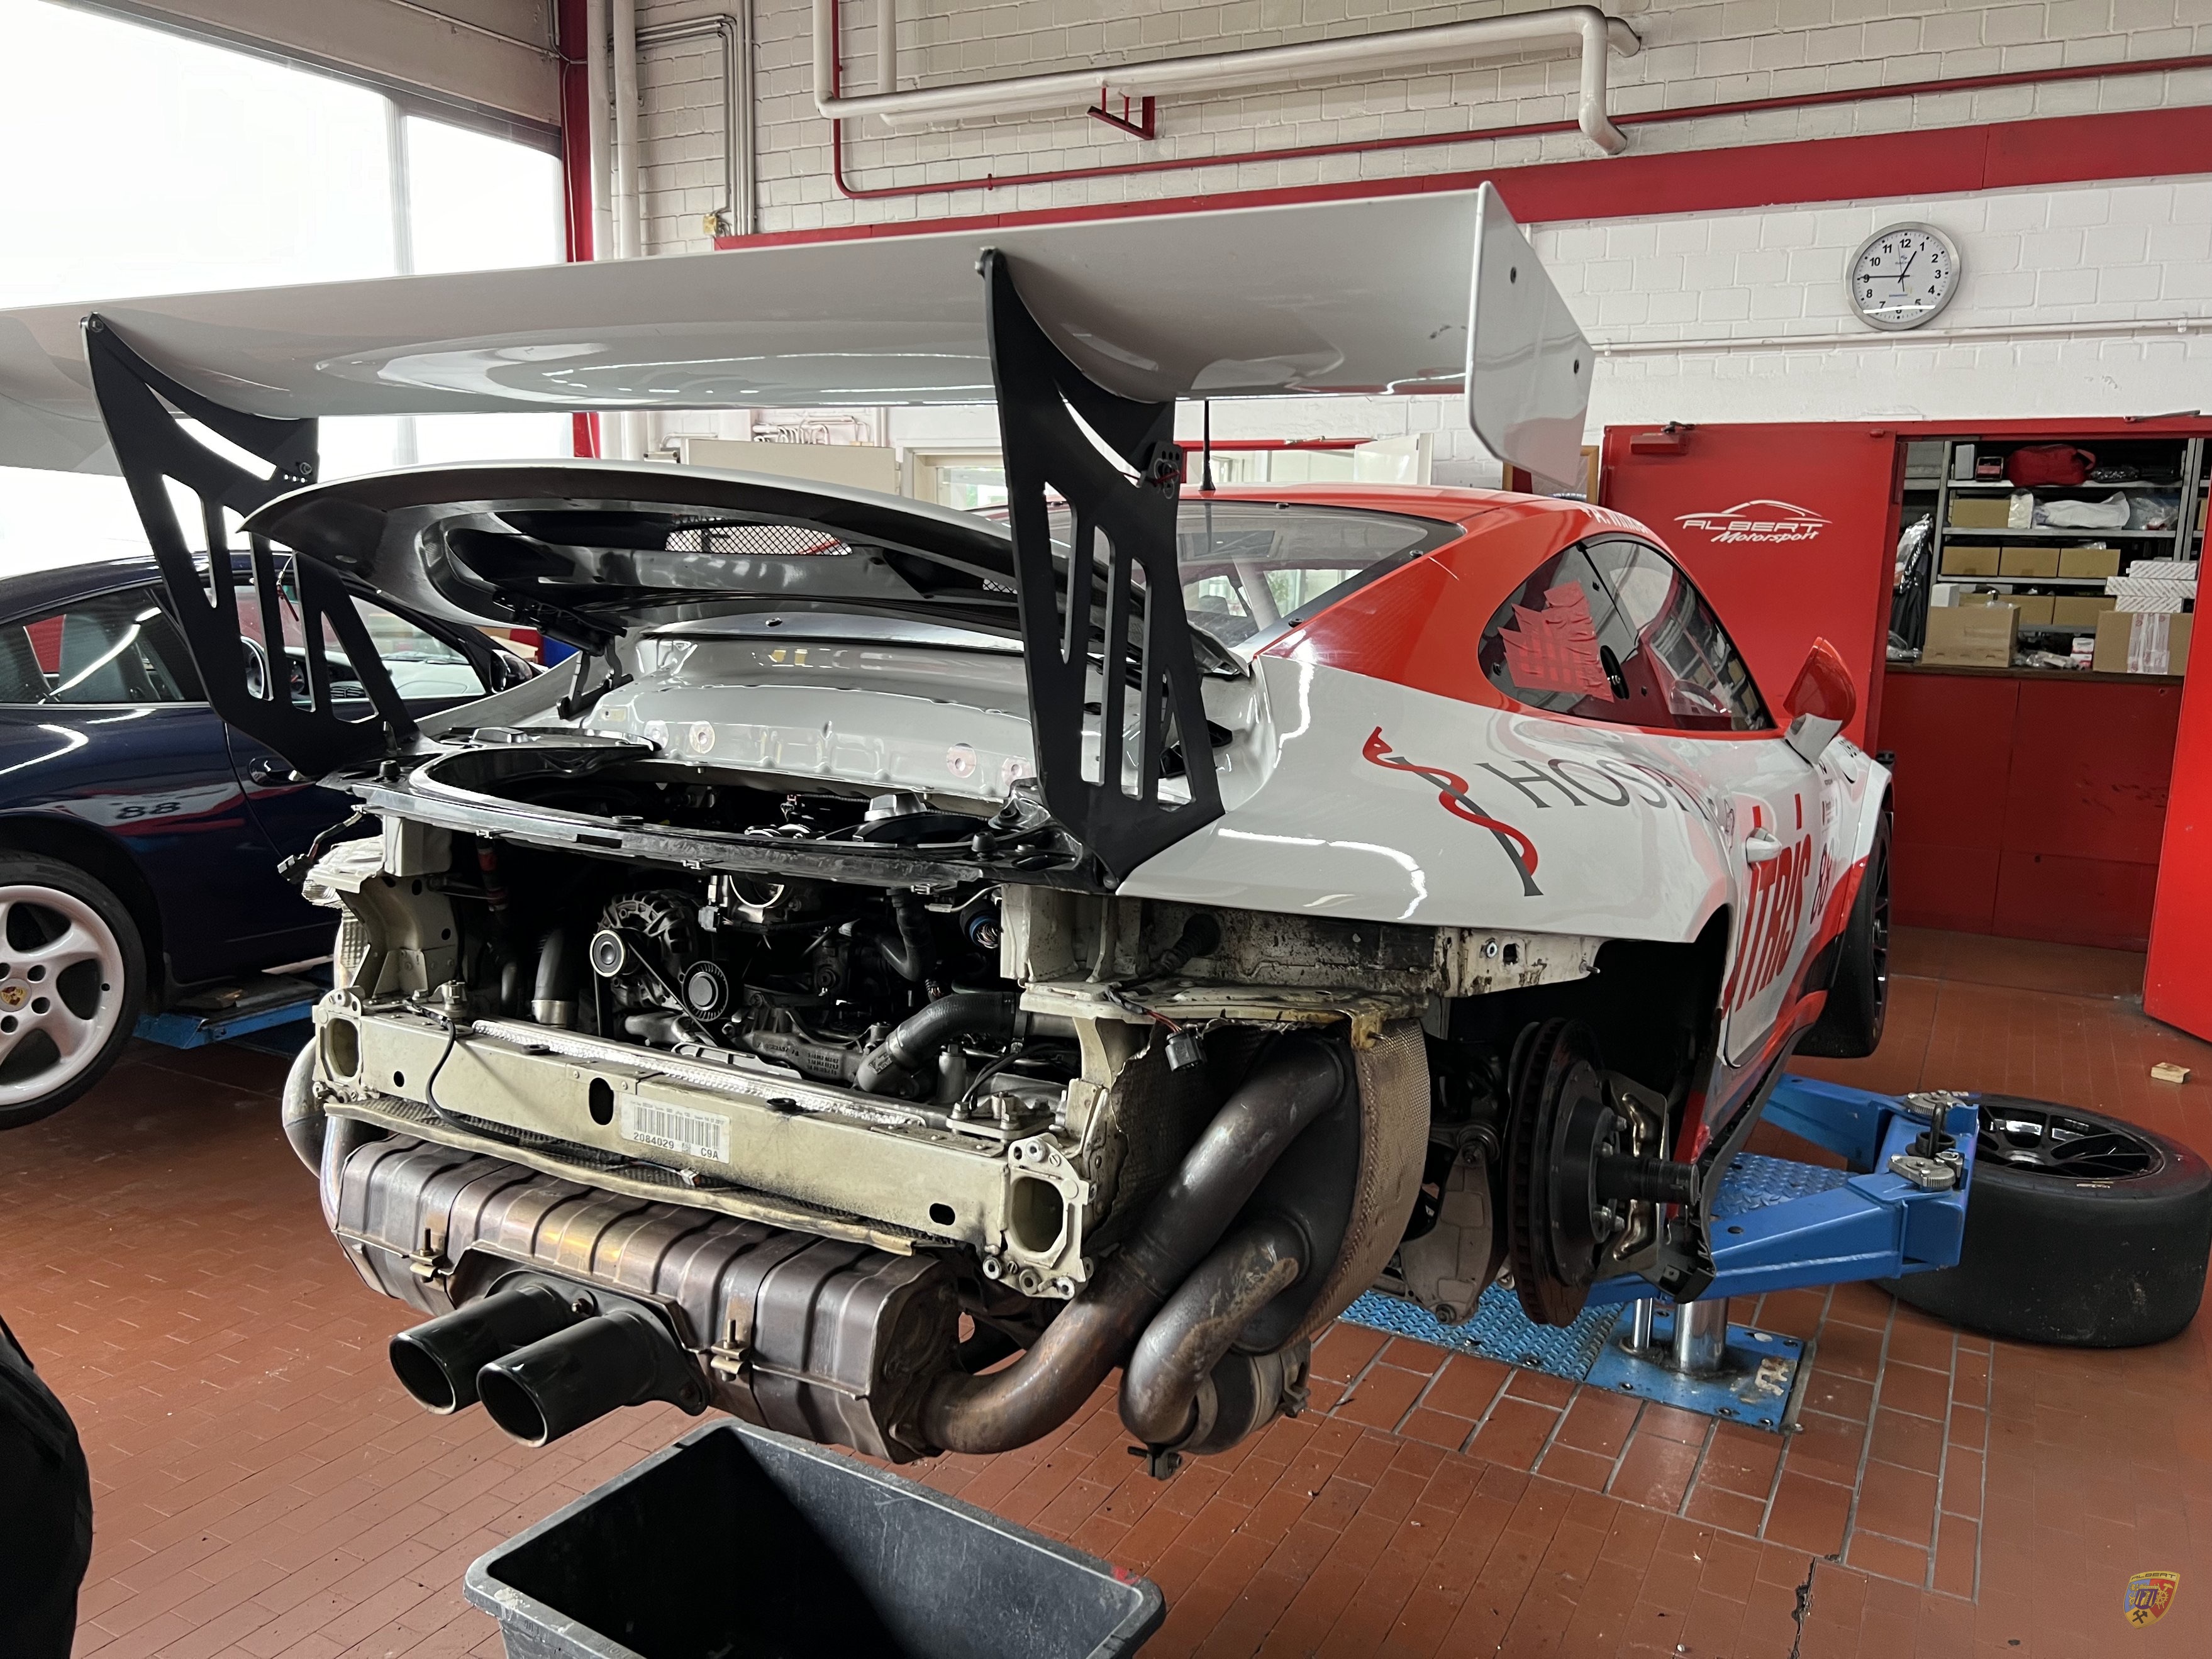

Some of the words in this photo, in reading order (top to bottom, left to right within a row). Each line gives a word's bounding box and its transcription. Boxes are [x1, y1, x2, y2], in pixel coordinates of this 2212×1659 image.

[1899, 238, 1911, 248] 12
[1920, 242, 1925, 251] 1
[1882, 244, 1892, 253] 11
[1869, 257, 1881, 267] 10
[1931, 253, 1938, 263] 2
[1864, 274, 1870, 283] 9
[1935, 270, 1942, 279] 3
[1866, 289, 1872, 298] 8
[1928, 285, 1935, 294] 4
[1879, 301, 1886, 309] 7
[1682, 519, 1823, 533] ALBERT
[1711, 530, 1819, 543] Motorsport
[633, 1131, 674, 1149] 2084029
[701, 1147, 719, 1160] C9A
